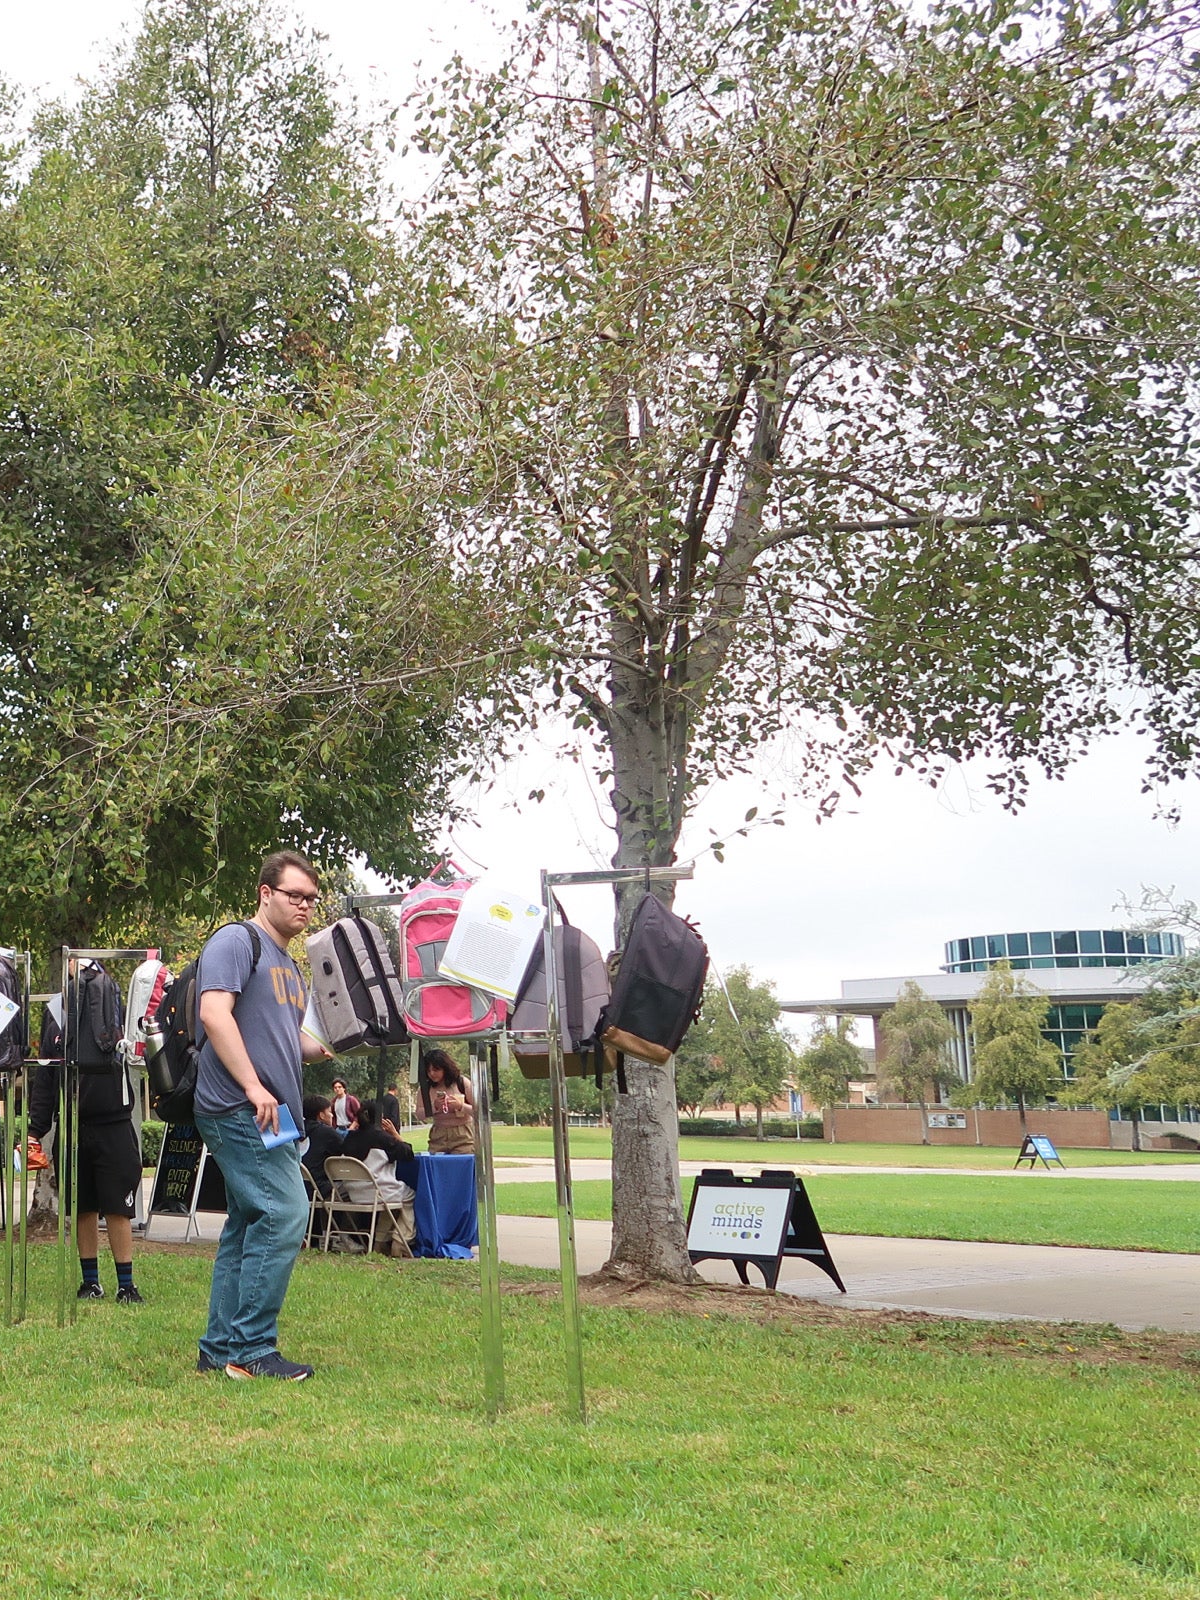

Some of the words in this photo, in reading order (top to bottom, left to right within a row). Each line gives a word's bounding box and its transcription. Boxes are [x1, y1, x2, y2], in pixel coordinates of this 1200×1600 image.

[168, 1140, 198, 1153] SILENCE
[167, 1169, 191, 1183] ENTER
[166, 1183, 188, 1199] HERE!
[714, 1202, 765, 1216] active
[711, 1214, 763, 1229] minds
